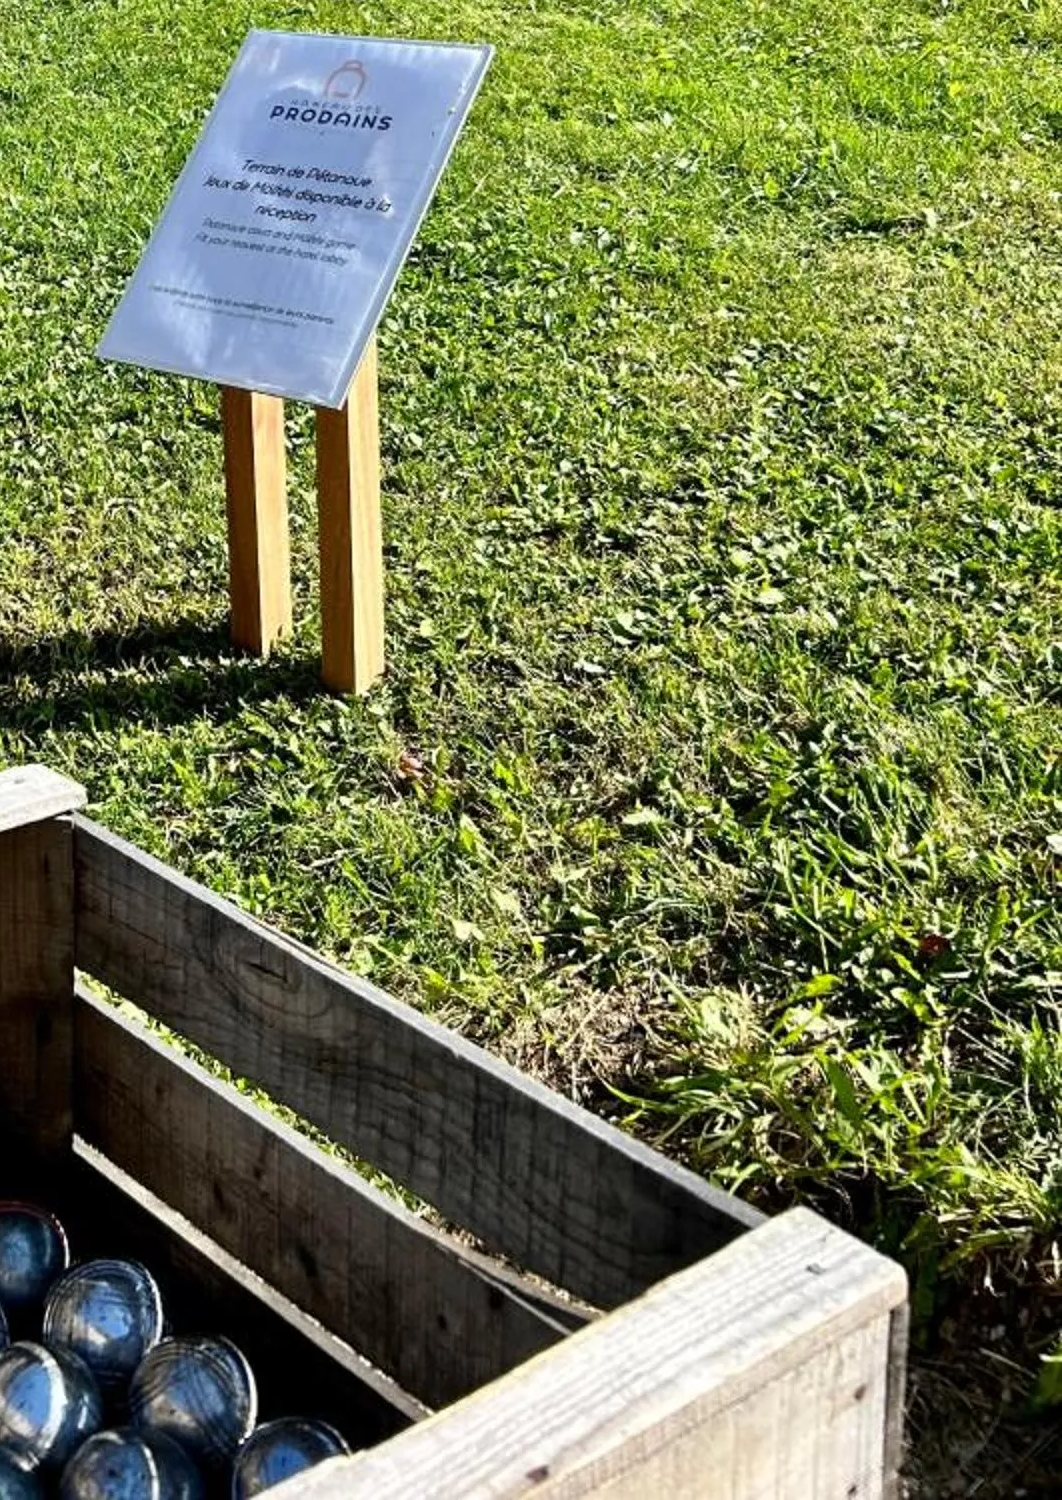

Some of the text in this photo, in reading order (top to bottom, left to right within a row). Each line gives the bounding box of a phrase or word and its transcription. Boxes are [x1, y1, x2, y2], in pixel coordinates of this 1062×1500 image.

[269, 105, 394, 131] PRODAINS
[241, 159, 285, 175] Terrain
[287, 167, 305, 178] de
[202, 174, 231, 189] Jeux
[232, 179, 250, 191] de
[295, 188, 362, 209] disponible
[376, 199, 391, 212] la
